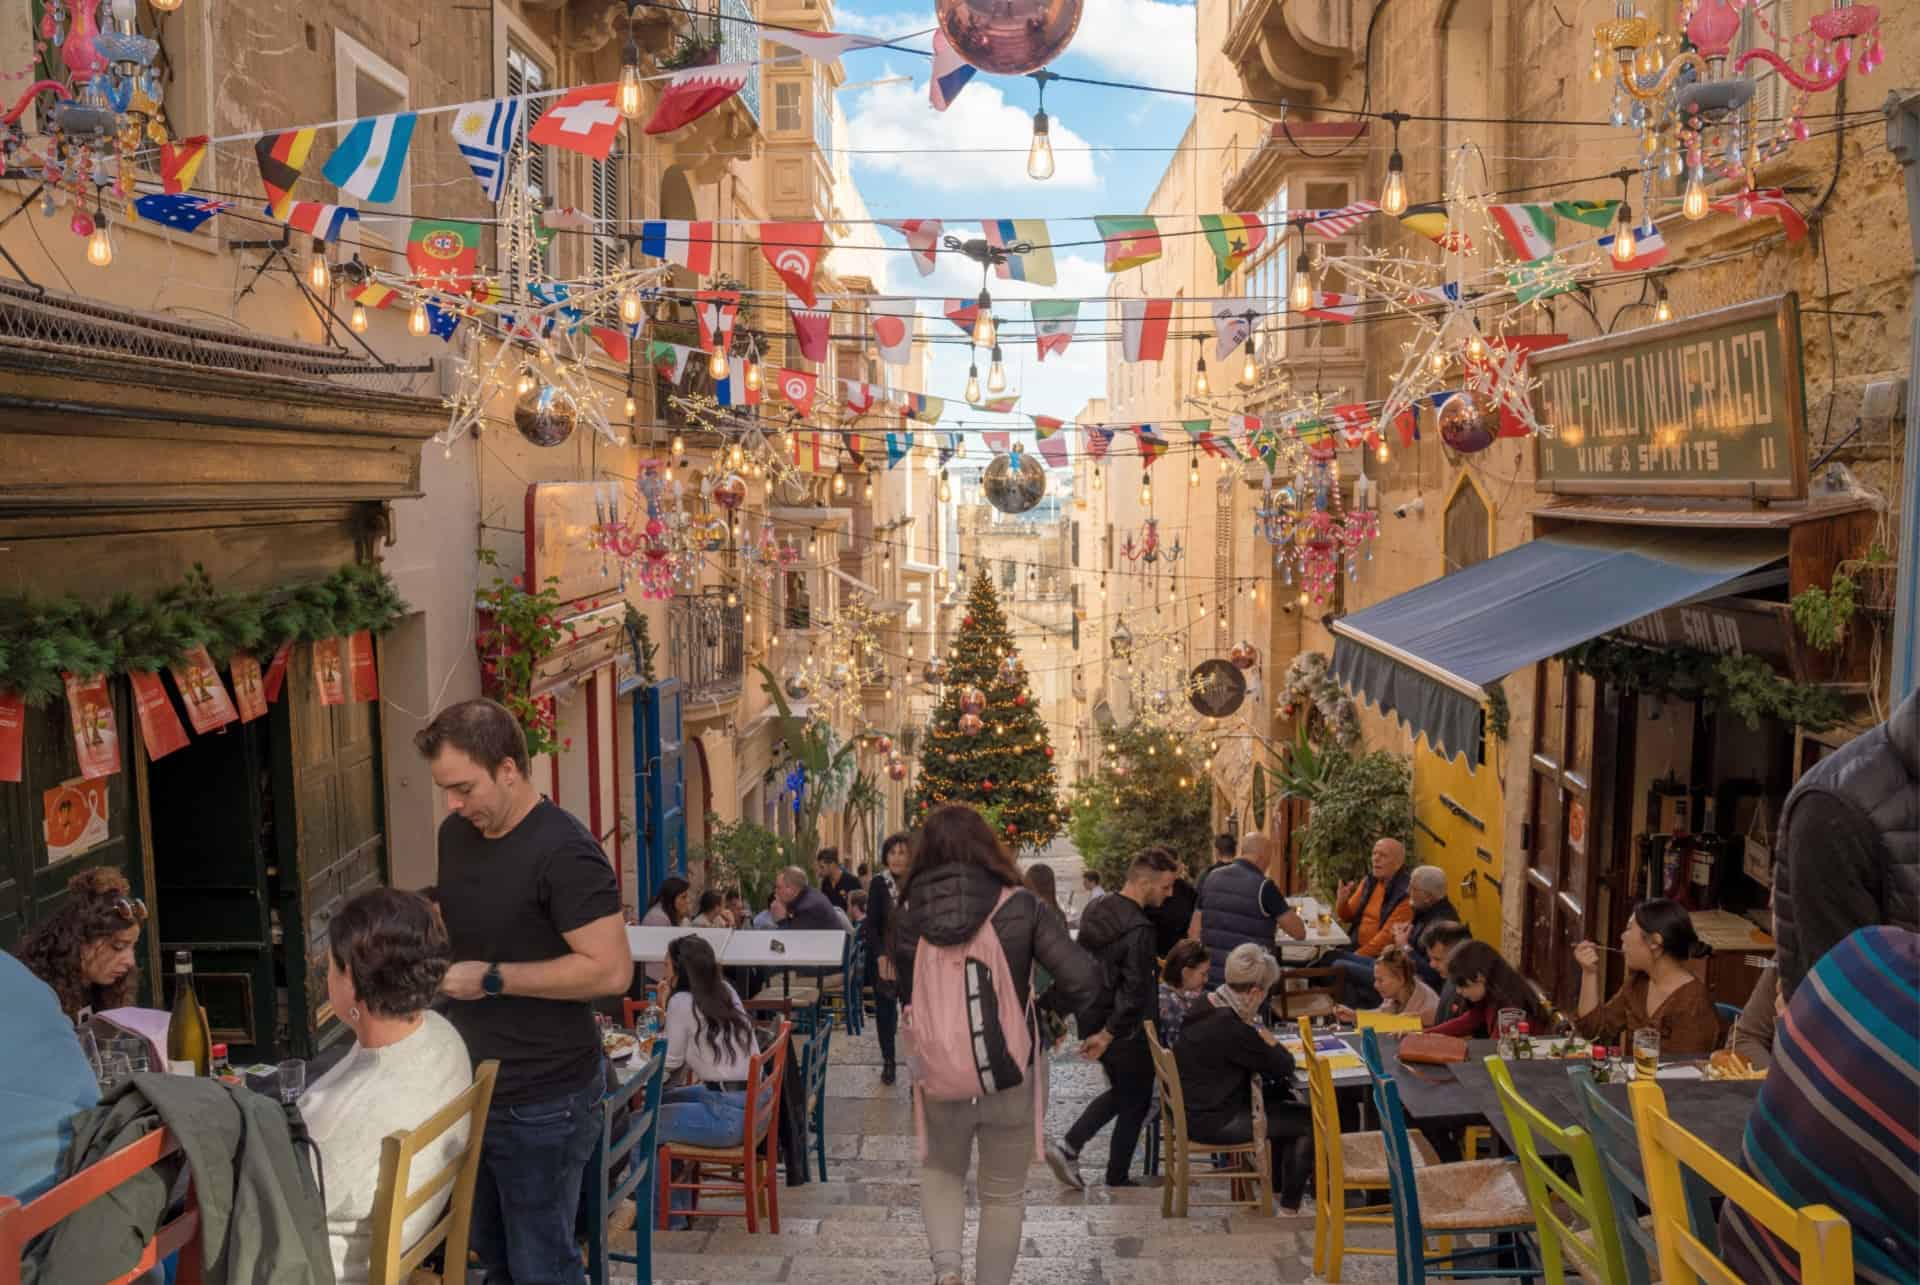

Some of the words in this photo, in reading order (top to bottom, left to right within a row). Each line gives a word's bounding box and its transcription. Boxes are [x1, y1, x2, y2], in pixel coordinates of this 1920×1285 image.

[1541, 367, 1574, 439] SAN
[1577, 357, 1640, 437] PAOLO
[1641, 330, 1773, 435] NAUFRAGO
[1621, 445, 1631, 473] &
[1638, 440, 1720, 473] SPIRITS
